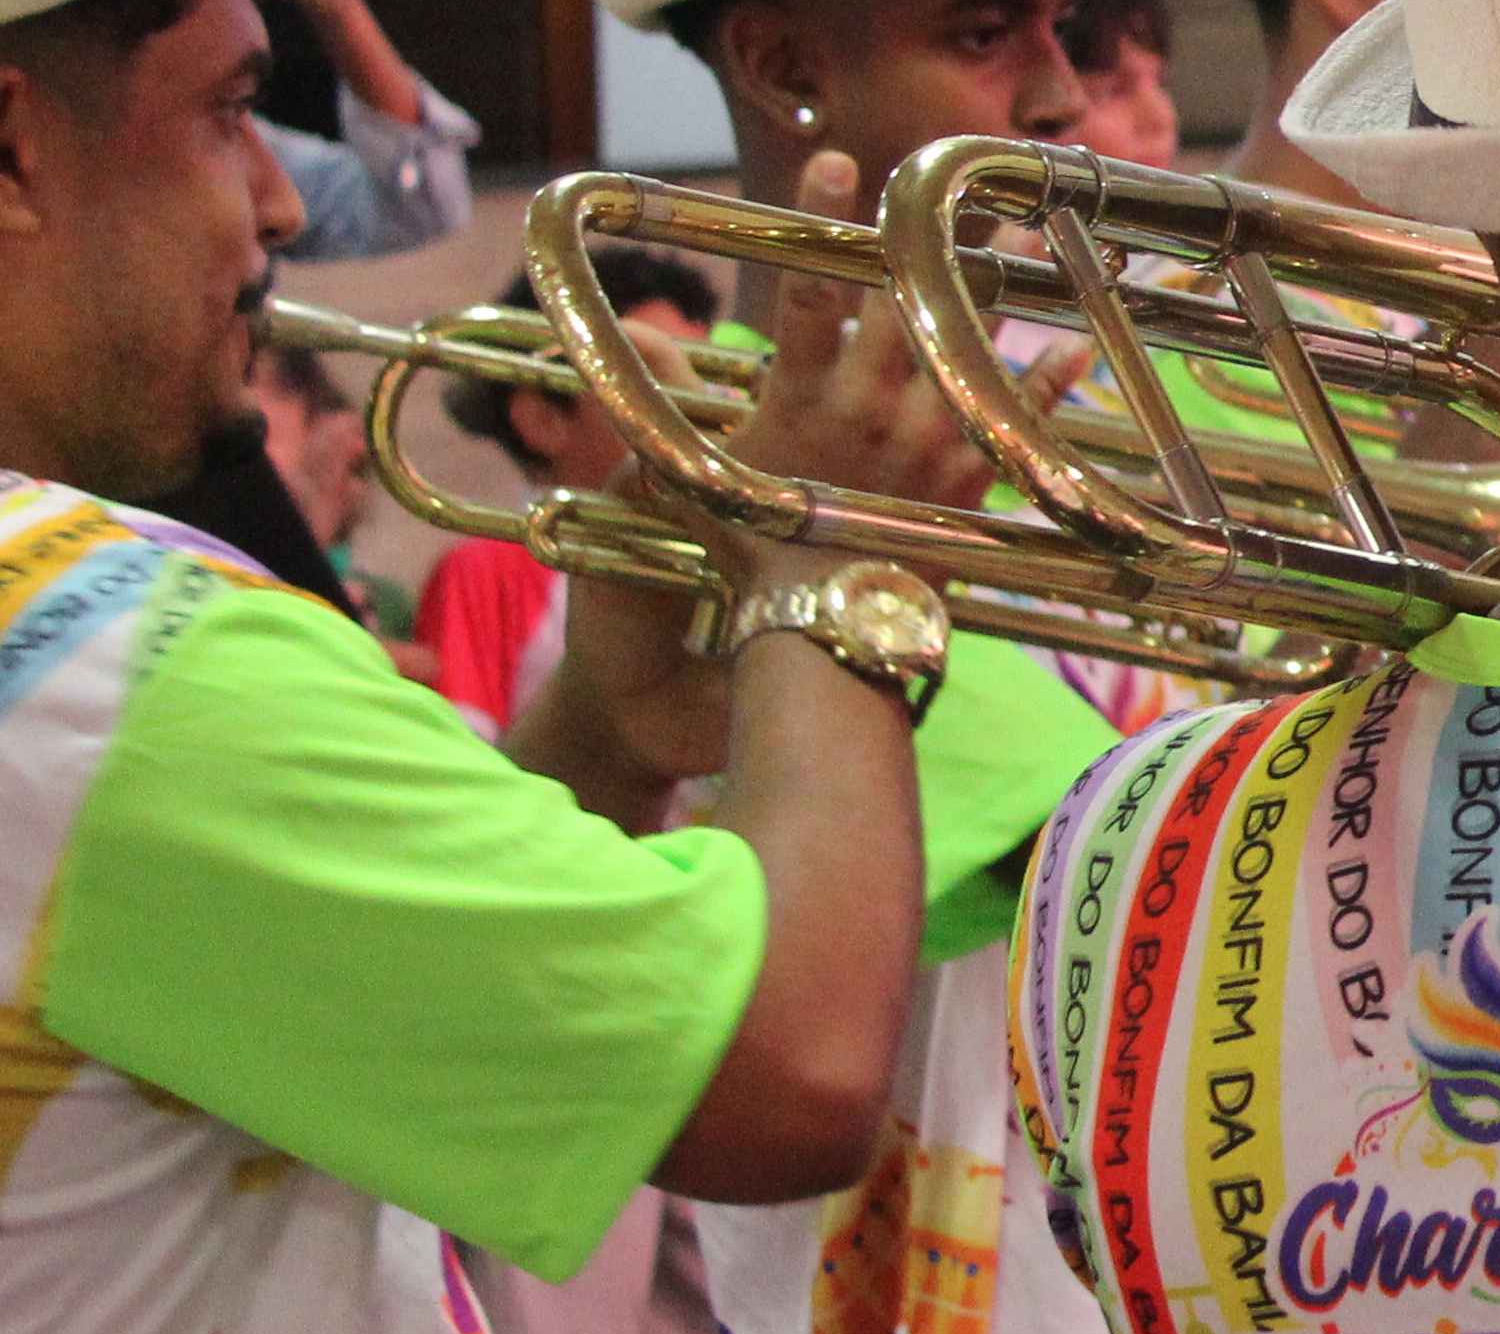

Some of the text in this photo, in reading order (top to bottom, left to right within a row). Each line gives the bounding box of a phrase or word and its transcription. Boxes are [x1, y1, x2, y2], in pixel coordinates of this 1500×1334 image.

[1267, 705, 1337, 781] DO
[1077, 851, 1114, 937] DO
[1142, 839, 1190, 919] DO
[1213, 795, 1288, 1045] BONFIM
[1327, 861, 1376, 952] DO
[1104, 937, 1161, 1167] BONFIM
[1208, 1071, 1257, 1162] DA
